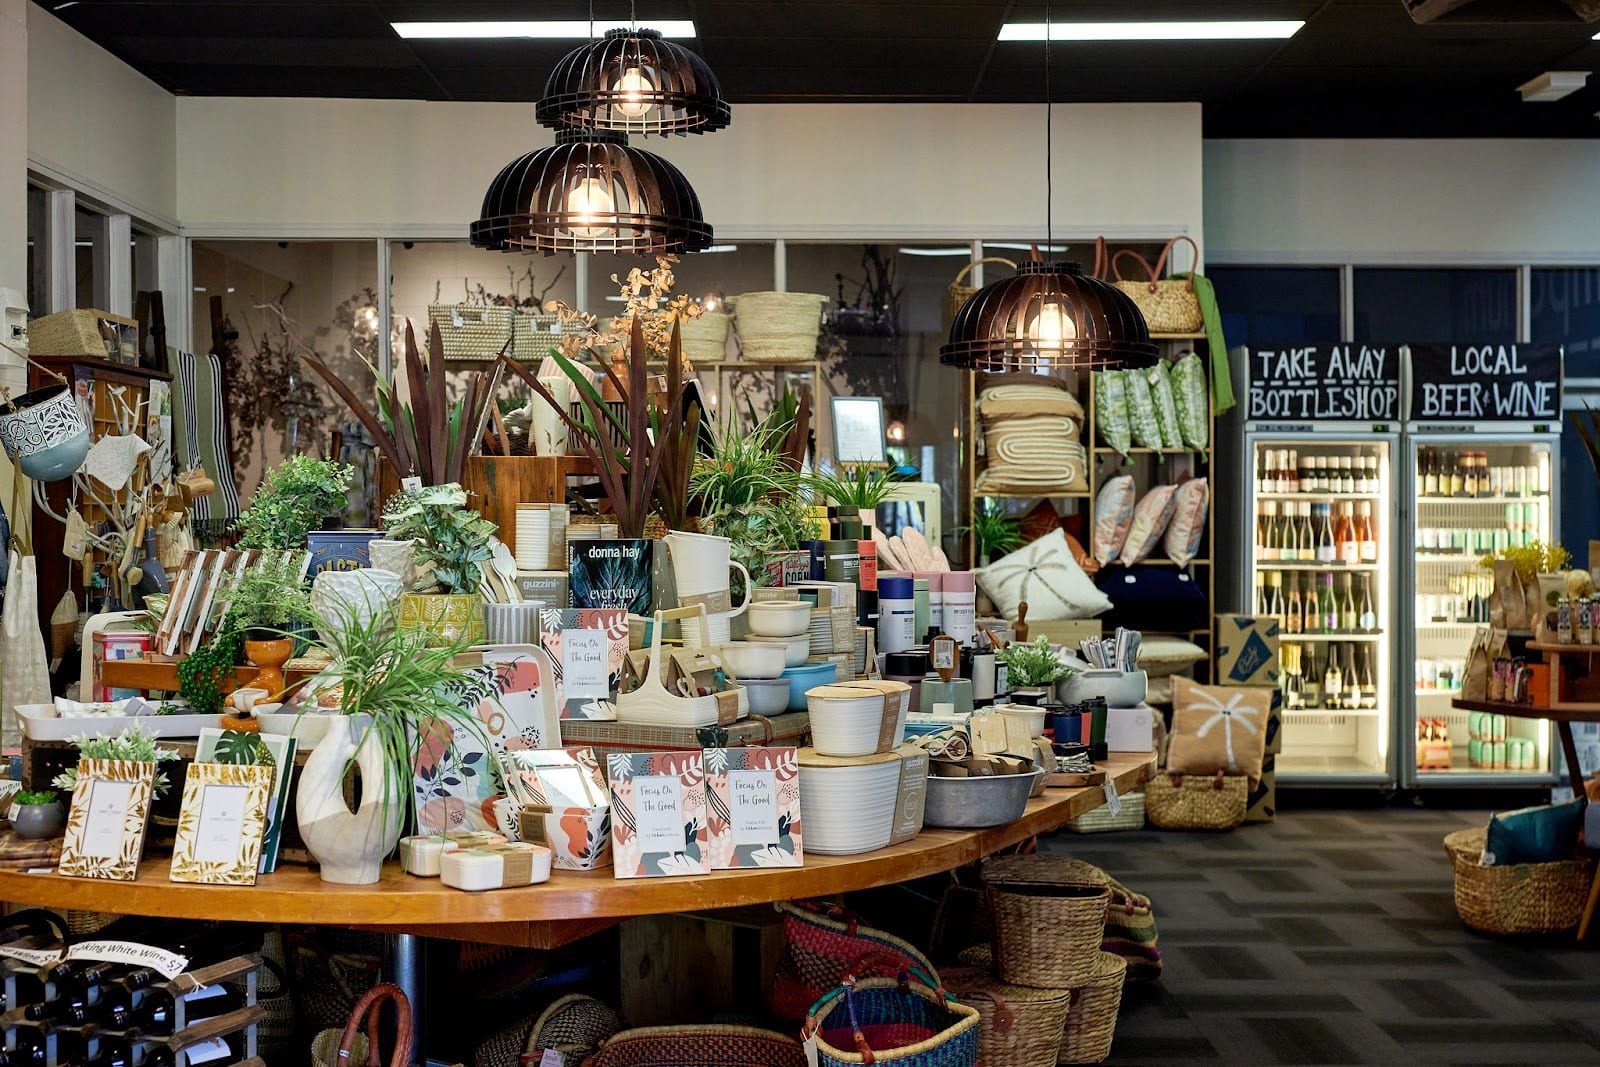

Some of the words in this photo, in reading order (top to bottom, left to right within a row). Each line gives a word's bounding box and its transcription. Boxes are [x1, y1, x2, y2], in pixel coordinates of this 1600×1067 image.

[1257, 347, 1317, 380] TAKE
[1327, 345, 1386, 380] AWAY
[1451, 344, 1528, 376] LOCAL
[1250, 386, 1397, 418] BOTTLESHOP
[1422, 382, 1483, 417] BEER
[1492, 381, 1557, 417] WINE
[588, 545, 620, 559] donna
[623, 545, 640, 560] hay
[523, 579, 556, 589] guzzini
[590, 585, 639, 601] everyday
[568, 639, 587, 648] Focus
[589, 639, 599, 647] On
[570, 651, 581, 661] The
[584, 652, 601, 661] Good
[640, 785, 660, 796] Focus
[661, 785, 673, 795] On
[735, 780, 755, 790] Focus
[756, 780, 767, 790] On
[642, 799, 656, 811] The
[657, 799, 676, 811] Good
[736, 793, 750, 805] The
[751, 793, 770, 805] Good
[107, 944, 137, 956] White
[139, 949, 167, 961] Wine
[166, 959, 183, 971] $7
